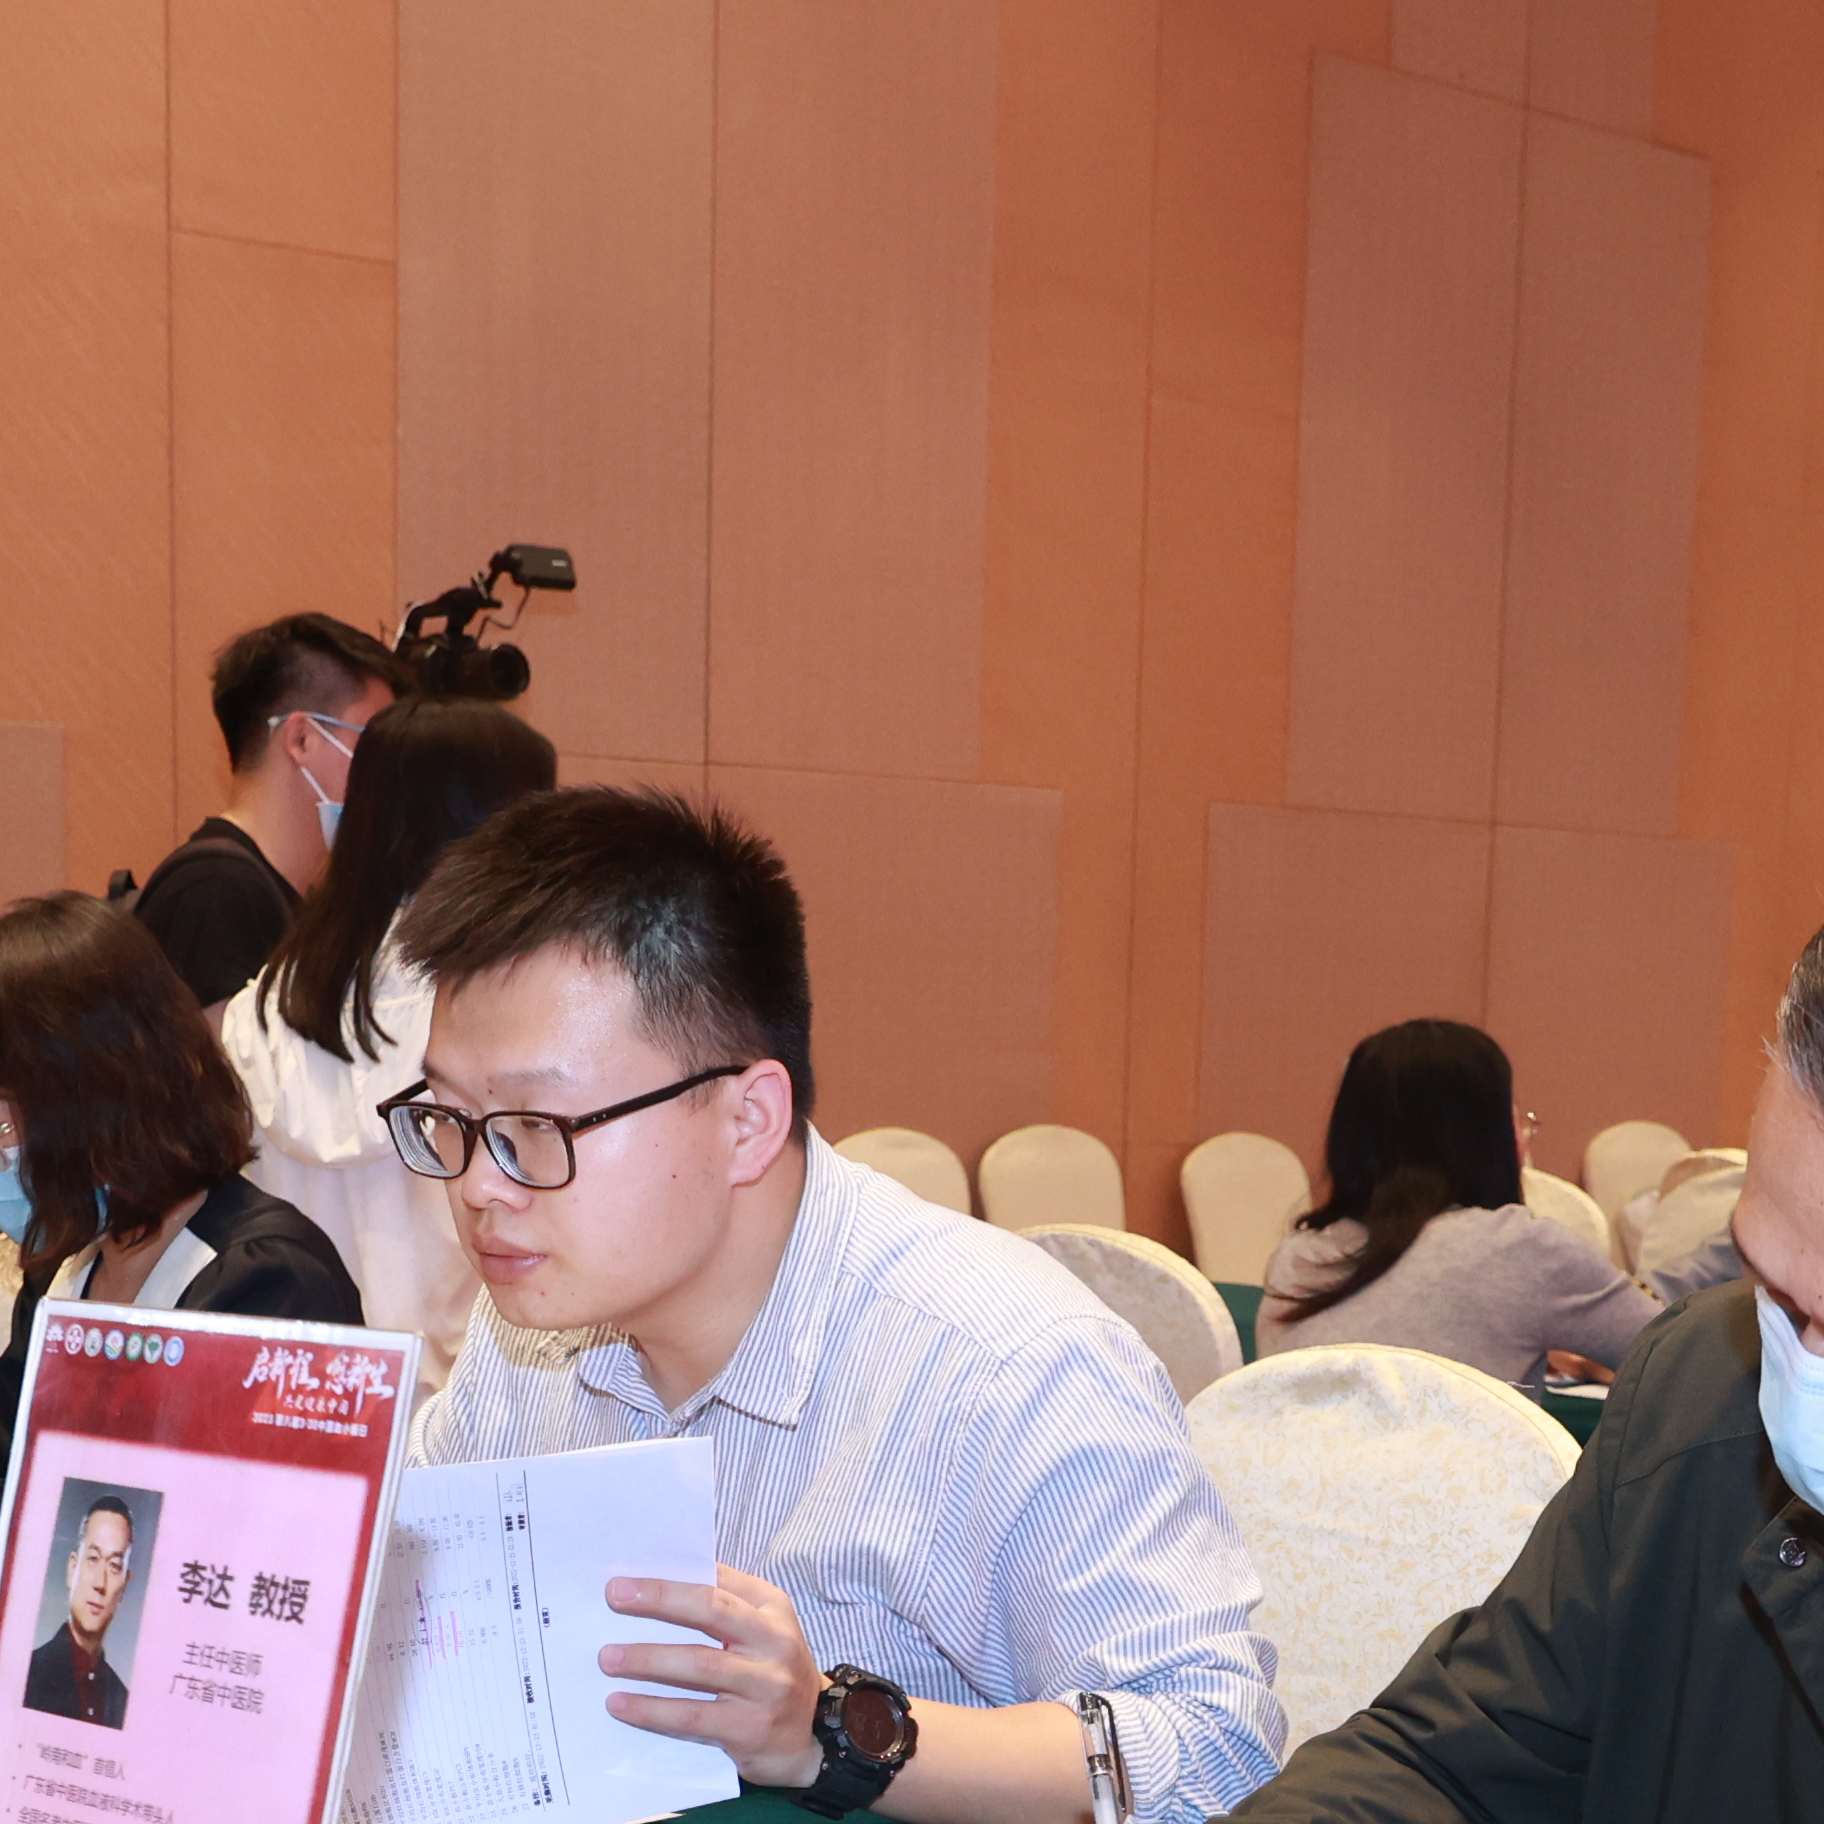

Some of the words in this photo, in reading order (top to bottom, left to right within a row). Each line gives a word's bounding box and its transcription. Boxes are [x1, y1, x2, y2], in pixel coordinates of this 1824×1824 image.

[178, 1560, 235, 1610] 李达
[248, 1572, 311, 1625] 教授
[182, 1642, 264, 1678] 主任中医师
[169, 1673, 264, 1714] 广东省中医院
